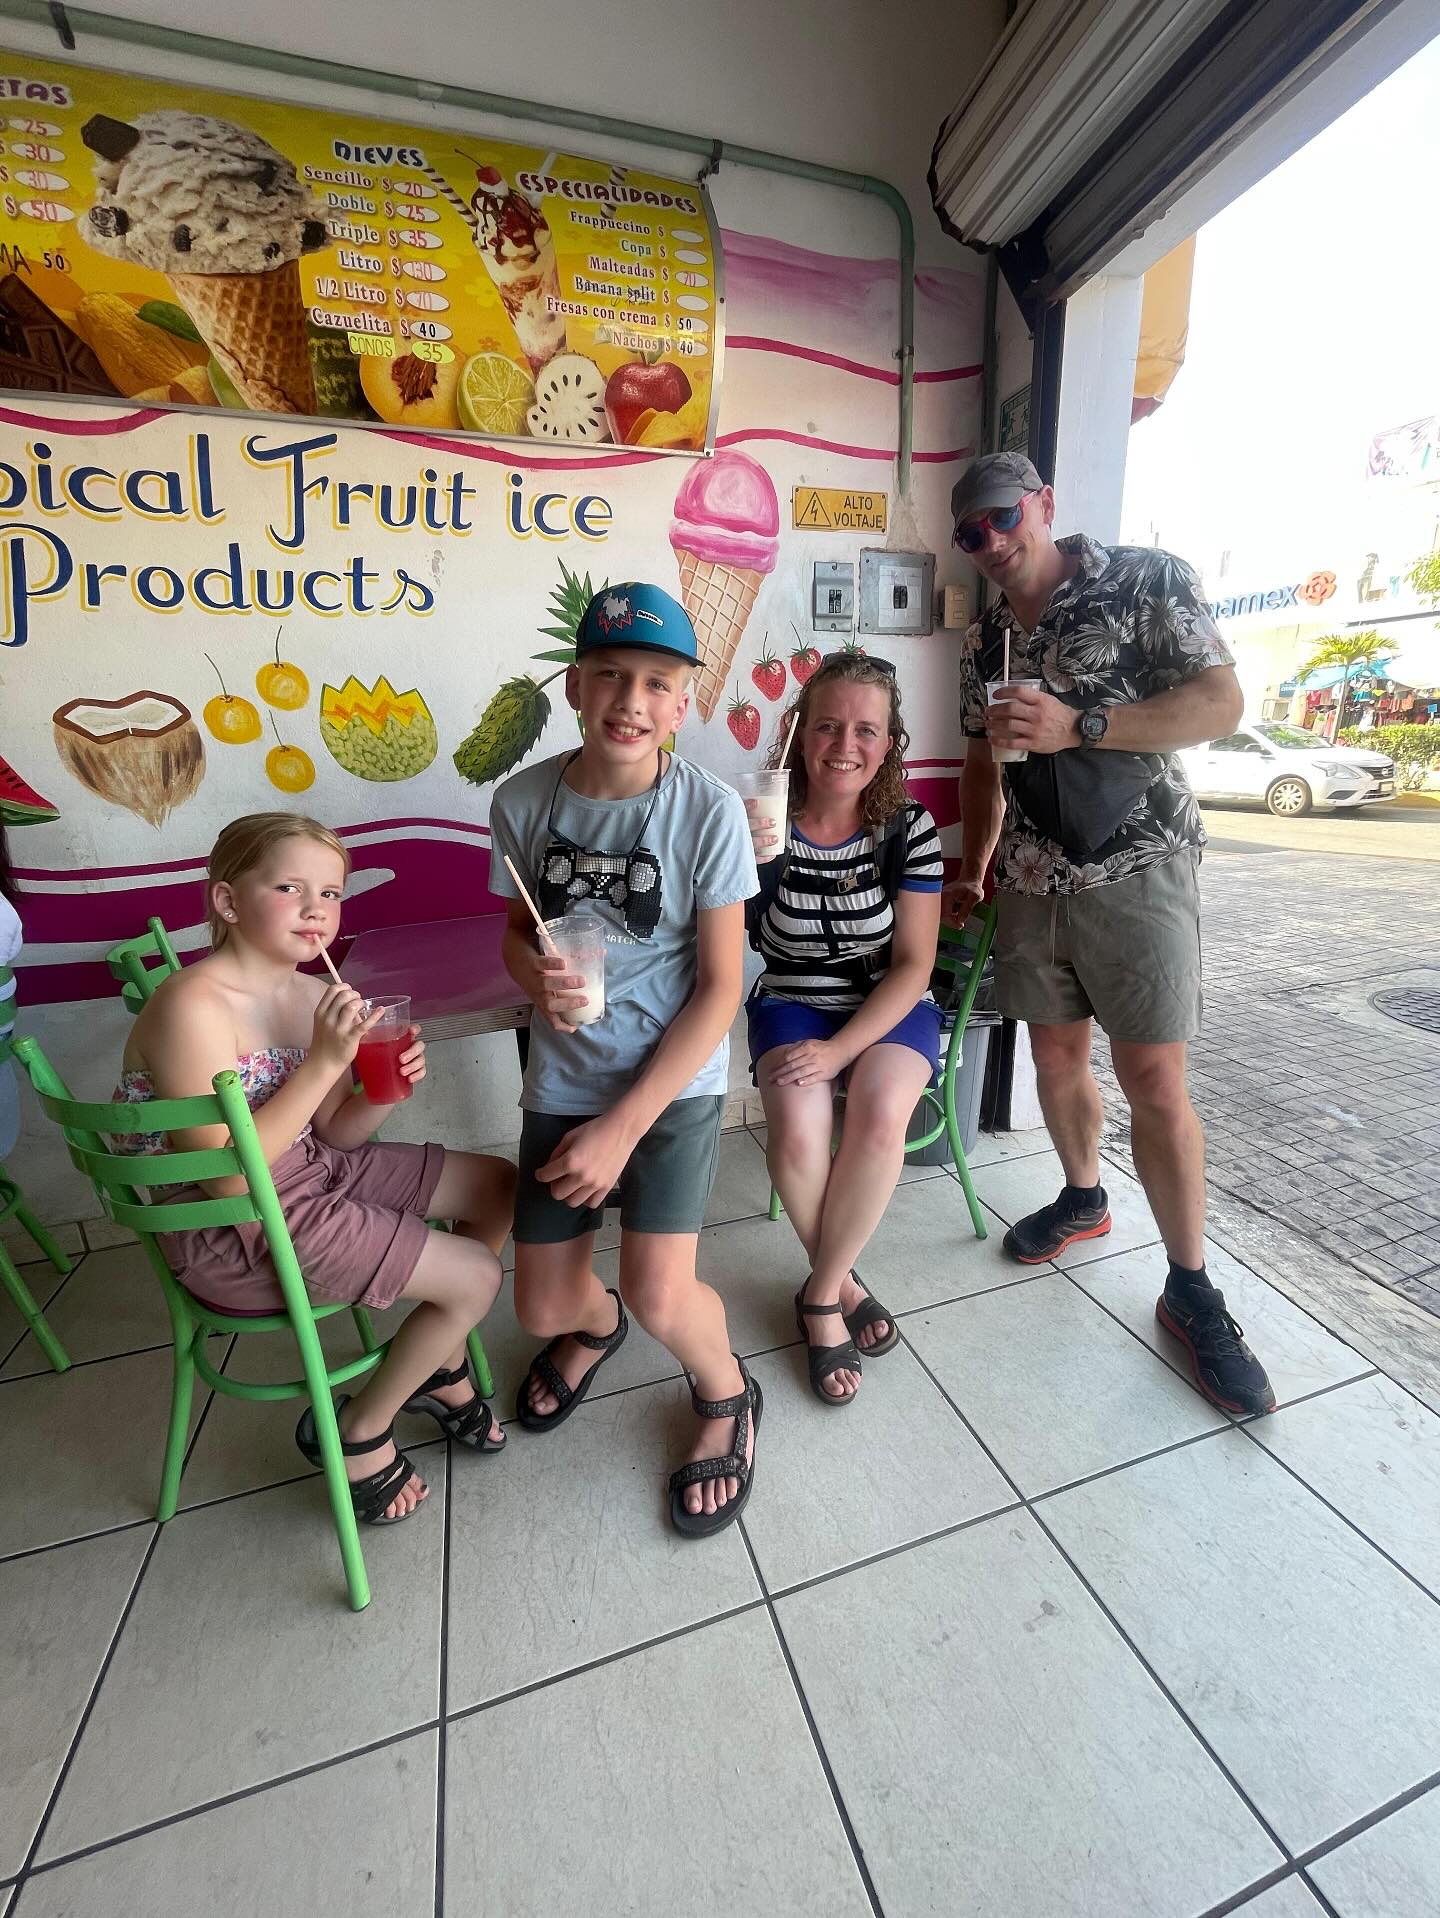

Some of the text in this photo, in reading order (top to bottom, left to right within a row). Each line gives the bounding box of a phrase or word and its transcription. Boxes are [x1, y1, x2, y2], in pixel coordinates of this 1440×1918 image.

[26, 119, 47, 136] 25
[25, 143, 50, 162] 30
[334, 141, 424, 167] NIEVES
[304, 166, 423, 197] Sencillo $ 20
[519, 173, 697, 214] ESPECIALIDADES
[5, 195, 57, 221] $ 50
[327, 193, 426, 221] Doble $ 25
[329, 220, 427, 248] Triple $ 35
[570, 211, 665, 237] Frappuccino $
[43, 252, 65, 271] 50
[621, 239, 666, 258] Copa $
[339, 250, 381, 271] Litro
[391, 258, 400, 275] $
[590, 256, 655, 279] Malteadas
[662, 267, 669, 281] $
[316, 278, 338, 296] 1/2
[344, 281, 385, 303] Litro
[395, 288, 404, 305] $
[575, 276, 622, 296] Banana
[626, 285, 656, 303] split
[663, 290, 670, 304] $
[312, 307, 437, 338] Cazuelita $ 40
[547, 296, 692, 331] Fresas con crema $ 50
[349, 336, 443, 362] CONOS 35
[613, 332, 693, 354] Nachos $ 40
[240, 433, 476, 553] Fruit
[506, 471, 613, 542] ice
[843, 495, 873, 511] ALTO
[833, 511, 883, 529] VOLTAJE
[0, 522, 434, 648] Products
